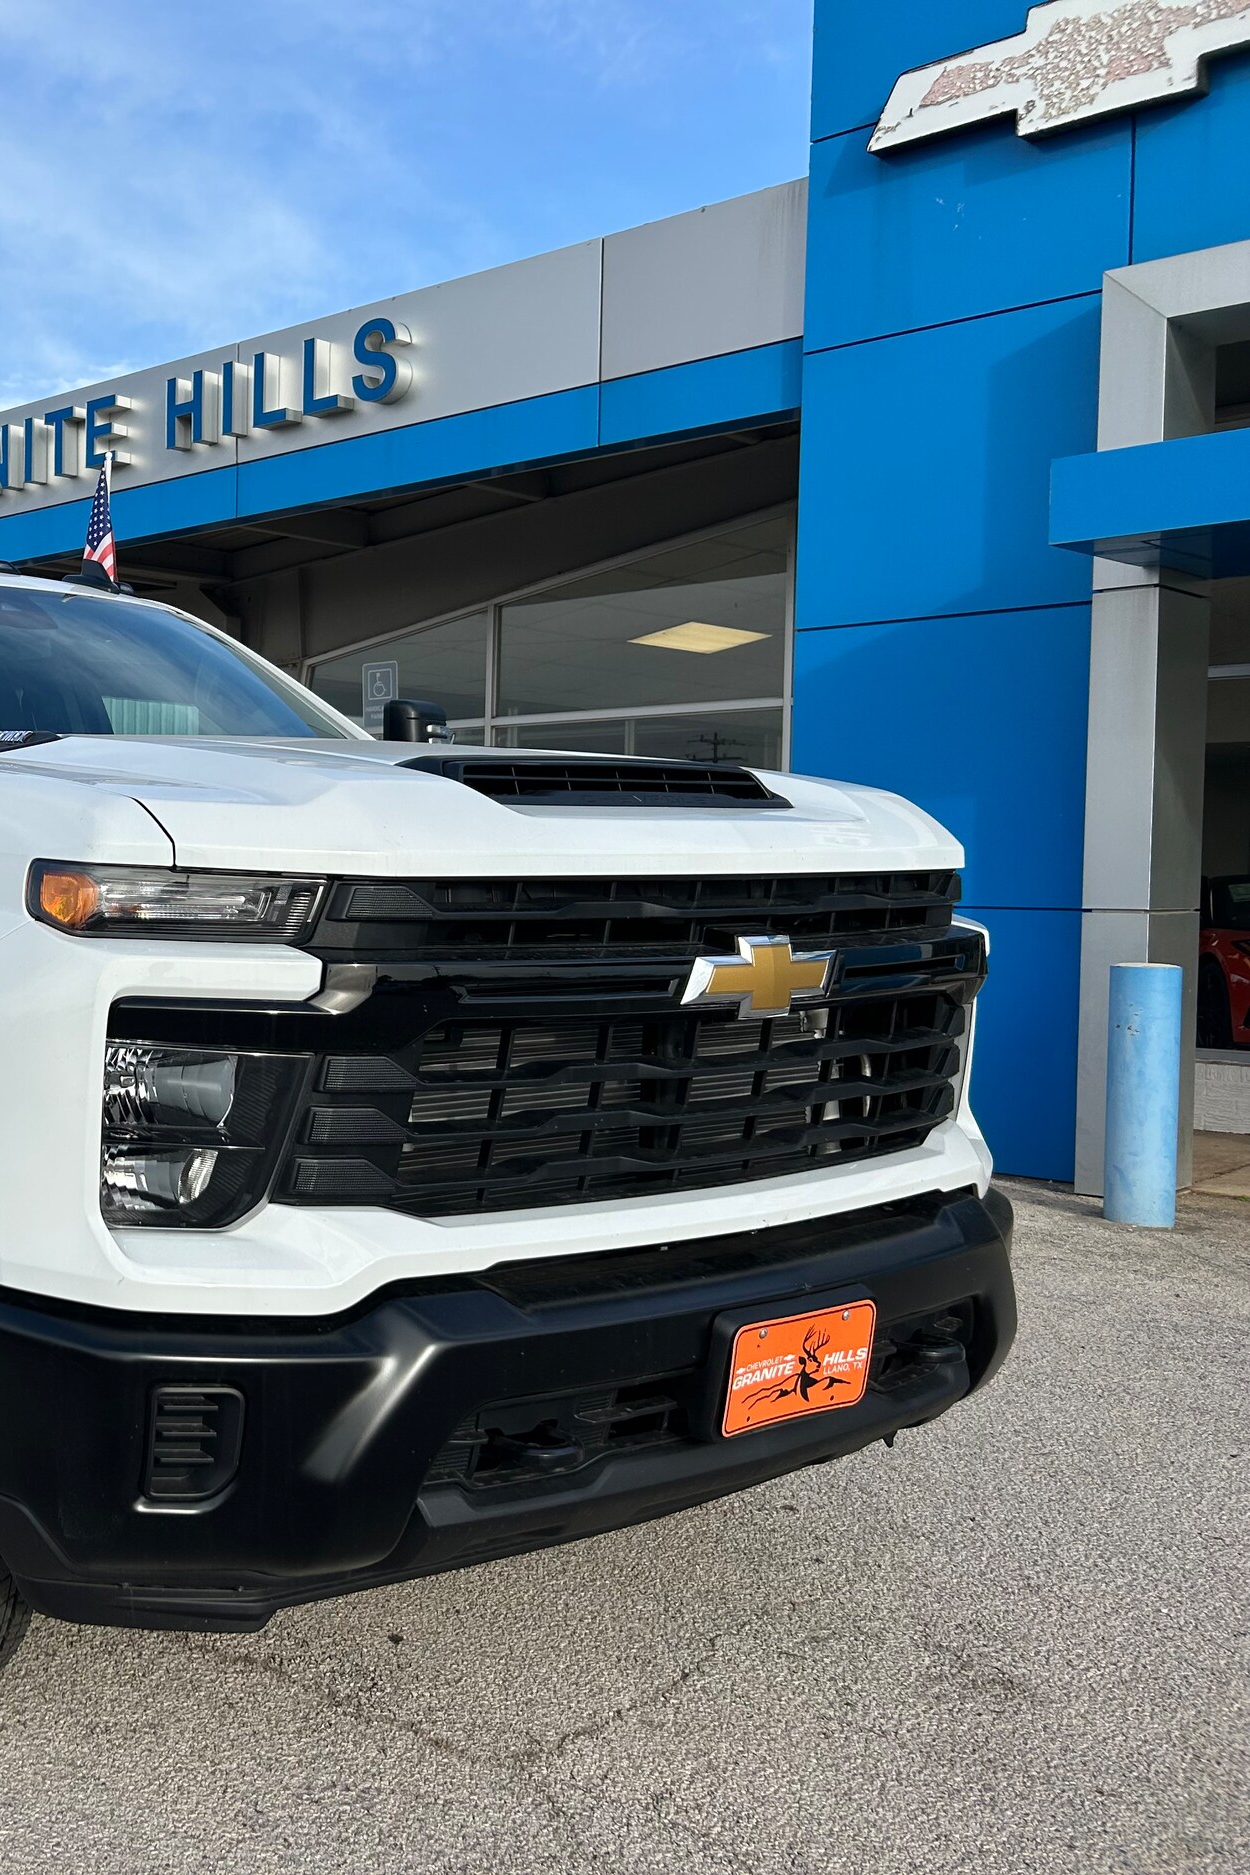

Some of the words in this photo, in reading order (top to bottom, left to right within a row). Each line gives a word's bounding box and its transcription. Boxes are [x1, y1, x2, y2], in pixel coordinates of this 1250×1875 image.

[166, 317, 412, 451] HILLS
[732, 1361, 796, 1390] GRANITE
[823, 1347, 868, 1366] HILLS
[746, 1355, 784, 1371] CHEVROLET
[822, 1363, 851, 1375] LLANO,
[853, 1361, 863, 1370] TX
